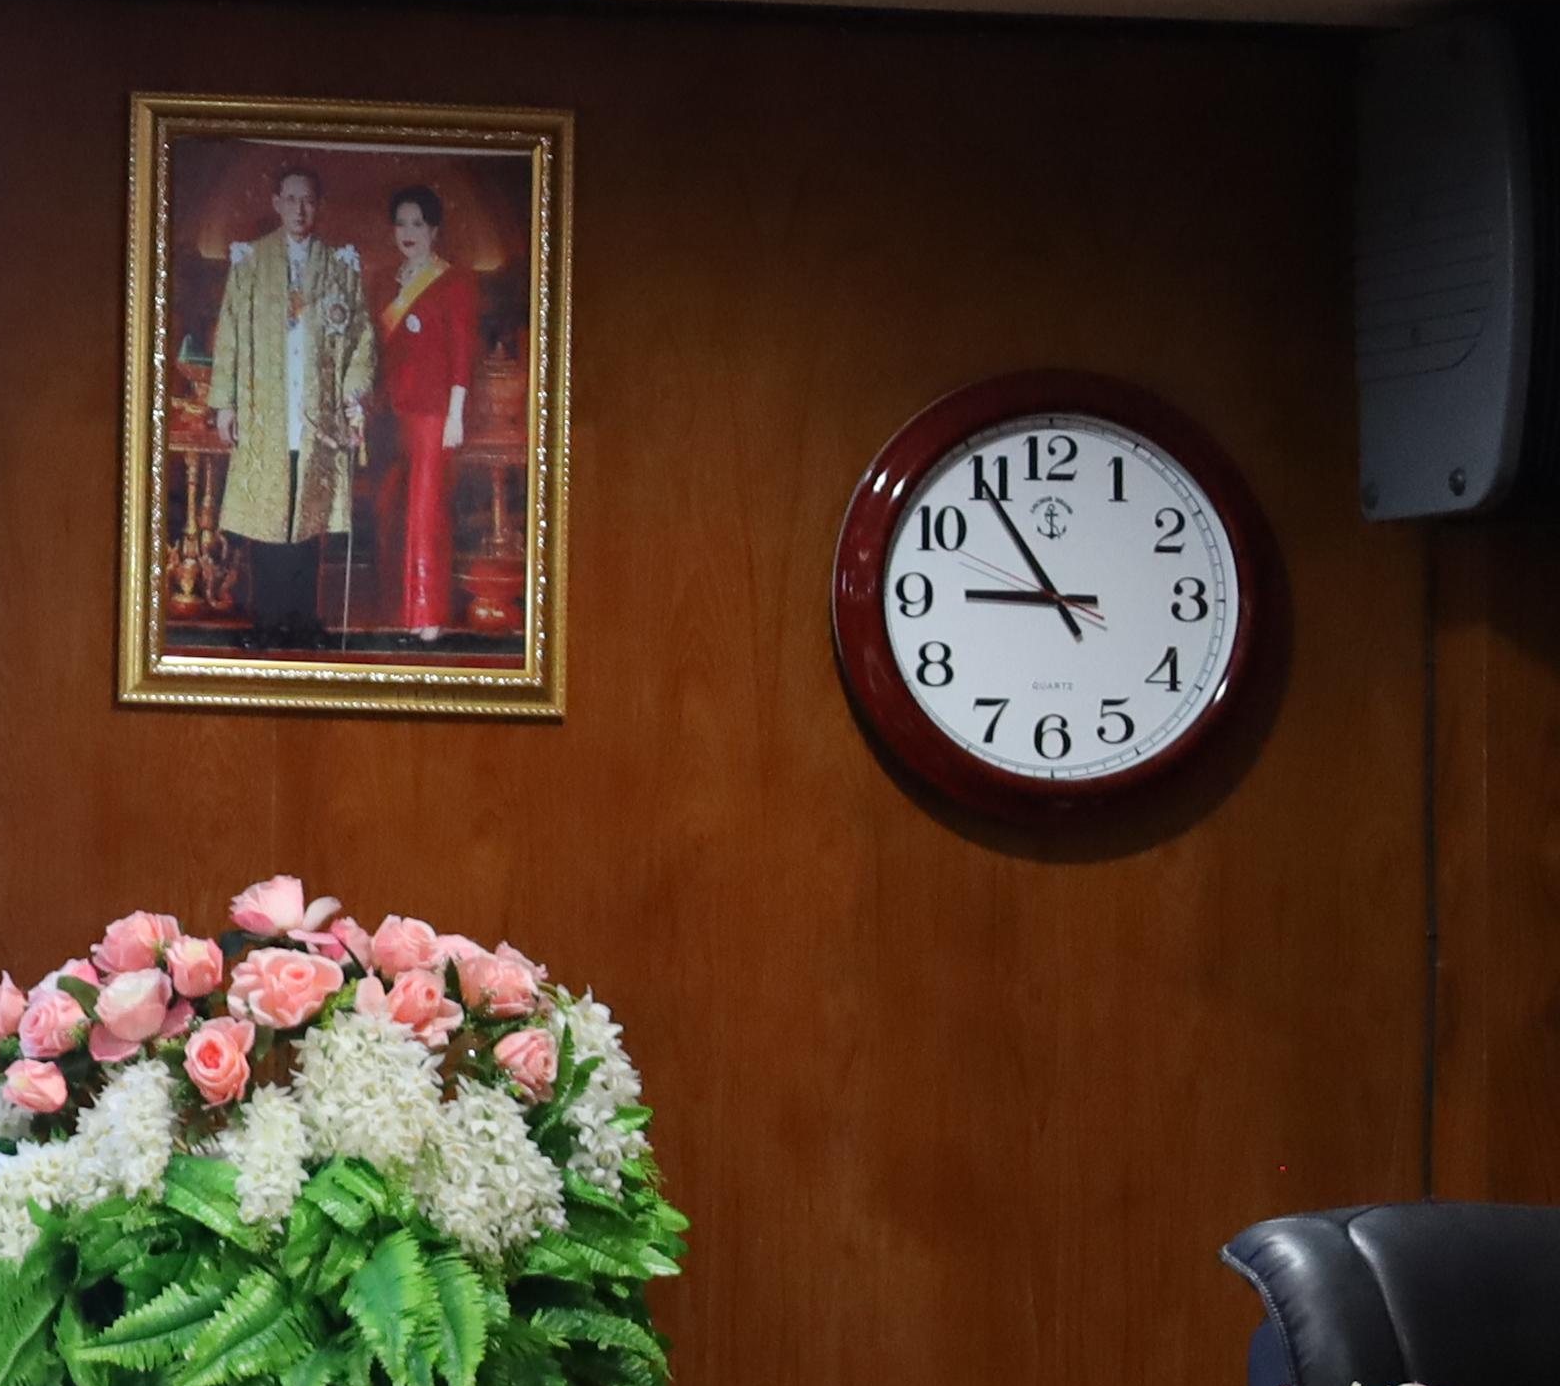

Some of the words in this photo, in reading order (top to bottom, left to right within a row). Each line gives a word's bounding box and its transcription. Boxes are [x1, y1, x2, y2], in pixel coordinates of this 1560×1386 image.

[968, 455, 1013, 501] 11
[1023, 435, 1078, 481] 12
[1107, 457, 1128, 502] 1
[915, 505, 967, 551] 10
[1154, 507, 1186, 553] 2
[895, 572, 934, 617] 9
[1170, 576, 1209, 623] 3
[915, 641, 954, 687] 8
[1145, 646, 1181, 692] 4
[972, 698, 1010, 743] 7
[1033, 714, 1072, 759] 6
[1096, 698, 1135, 744] 5
